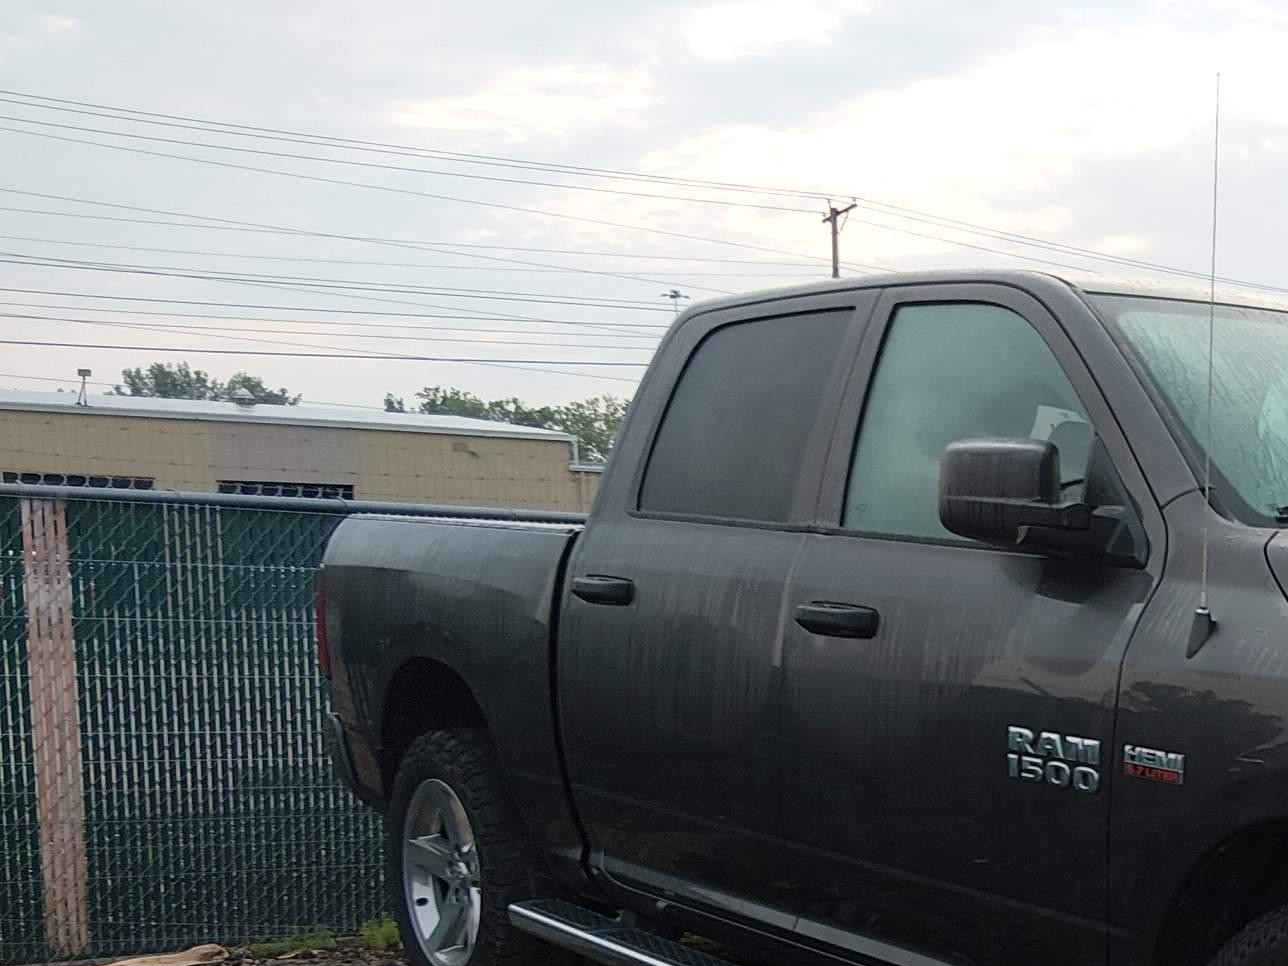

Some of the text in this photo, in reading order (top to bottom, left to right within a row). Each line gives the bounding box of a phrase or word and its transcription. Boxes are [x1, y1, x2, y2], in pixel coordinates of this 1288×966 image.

[1008, 726, 1100, 764] RAM
[1124, 744, 1185, 774] HEMI
[1007, 753, 1099, 793] 1500
